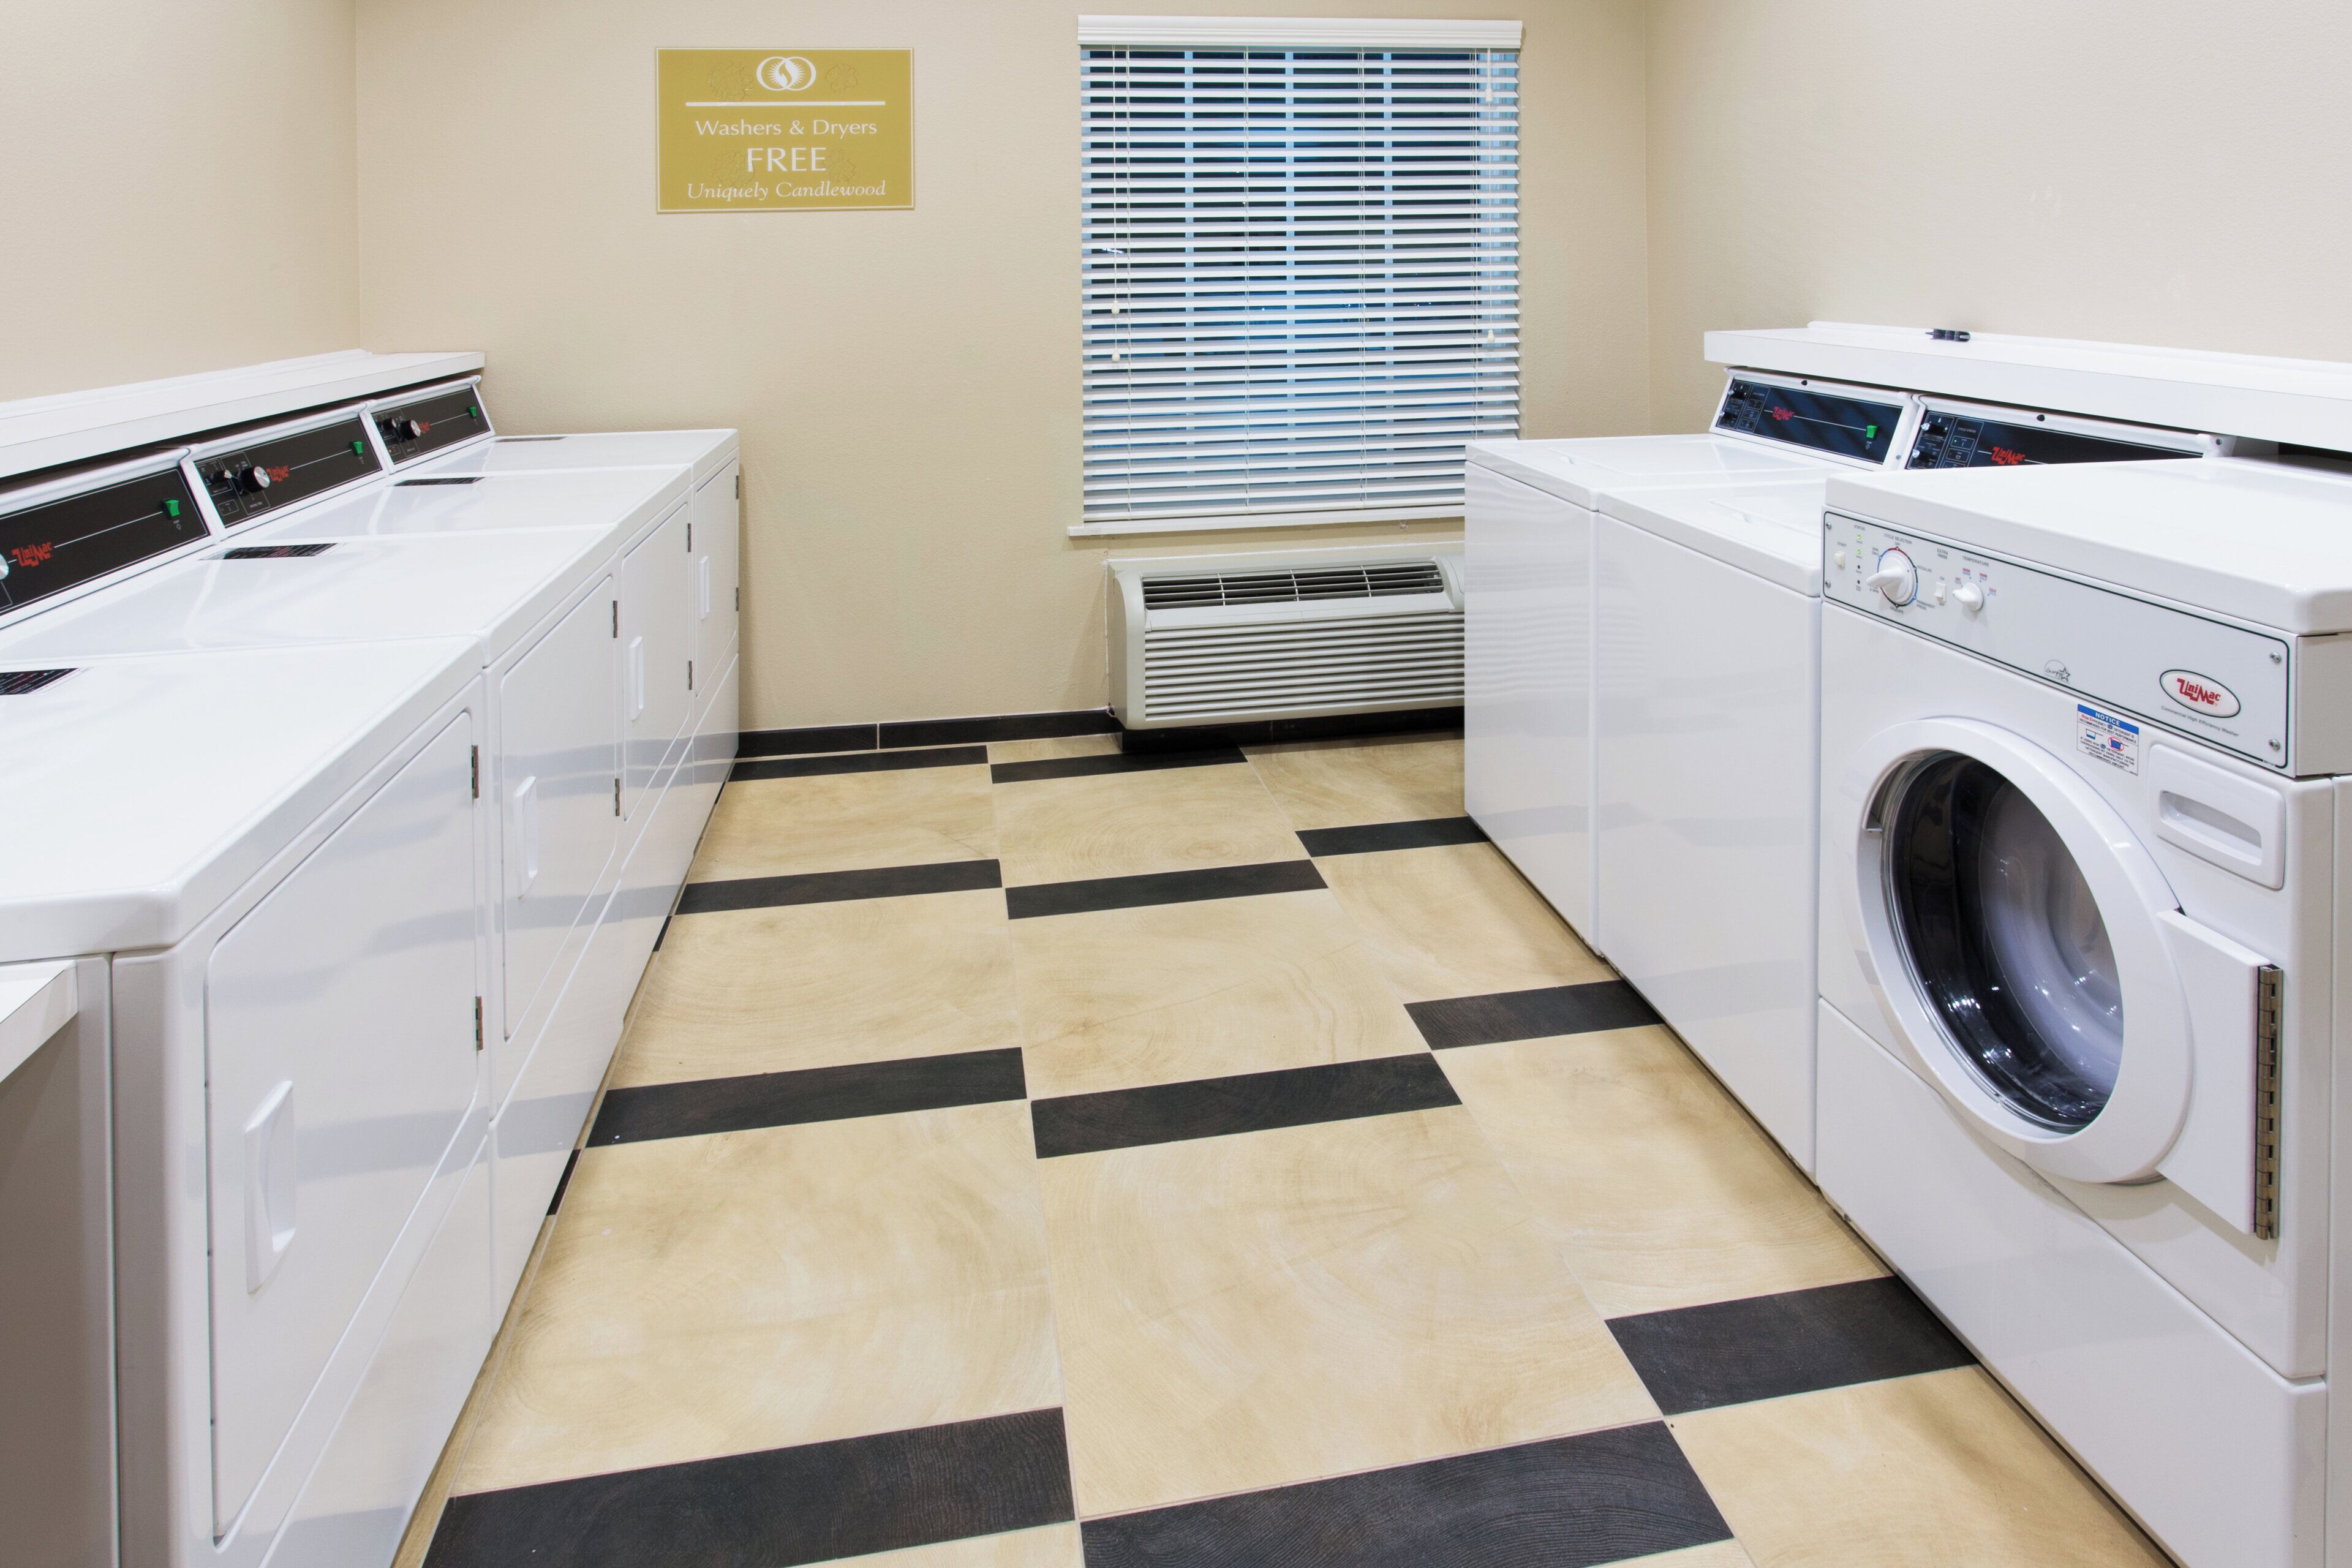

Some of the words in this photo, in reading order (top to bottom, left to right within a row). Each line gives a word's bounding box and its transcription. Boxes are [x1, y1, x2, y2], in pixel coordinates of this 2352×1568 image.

[695, 119, 782, 136] Washers
[790, 120, 805, 135] &
[813, 119, 878, 140] Dryers
[747, 147, 827, 173] FREE
[687, 182, 769, 202] Uniquely
[775, 180, 887, 198] Candlewood
[1991, 446, 2026, 465] UniMac
[1894, 536, 1912, 545] SELECTION
[11, 541, 53, 567] UniMac
[1962, 556, 1989, 567] TEMPERATURE
[2177, 677, 2222, 706] UniMac
[2095, 712, 2120, 726] NOTICE
[2161, 706, 2187, 718] Commercial
[2199, 719, 2221, 731] Efficiency
[2222, 727, 2239, 737] Washer
